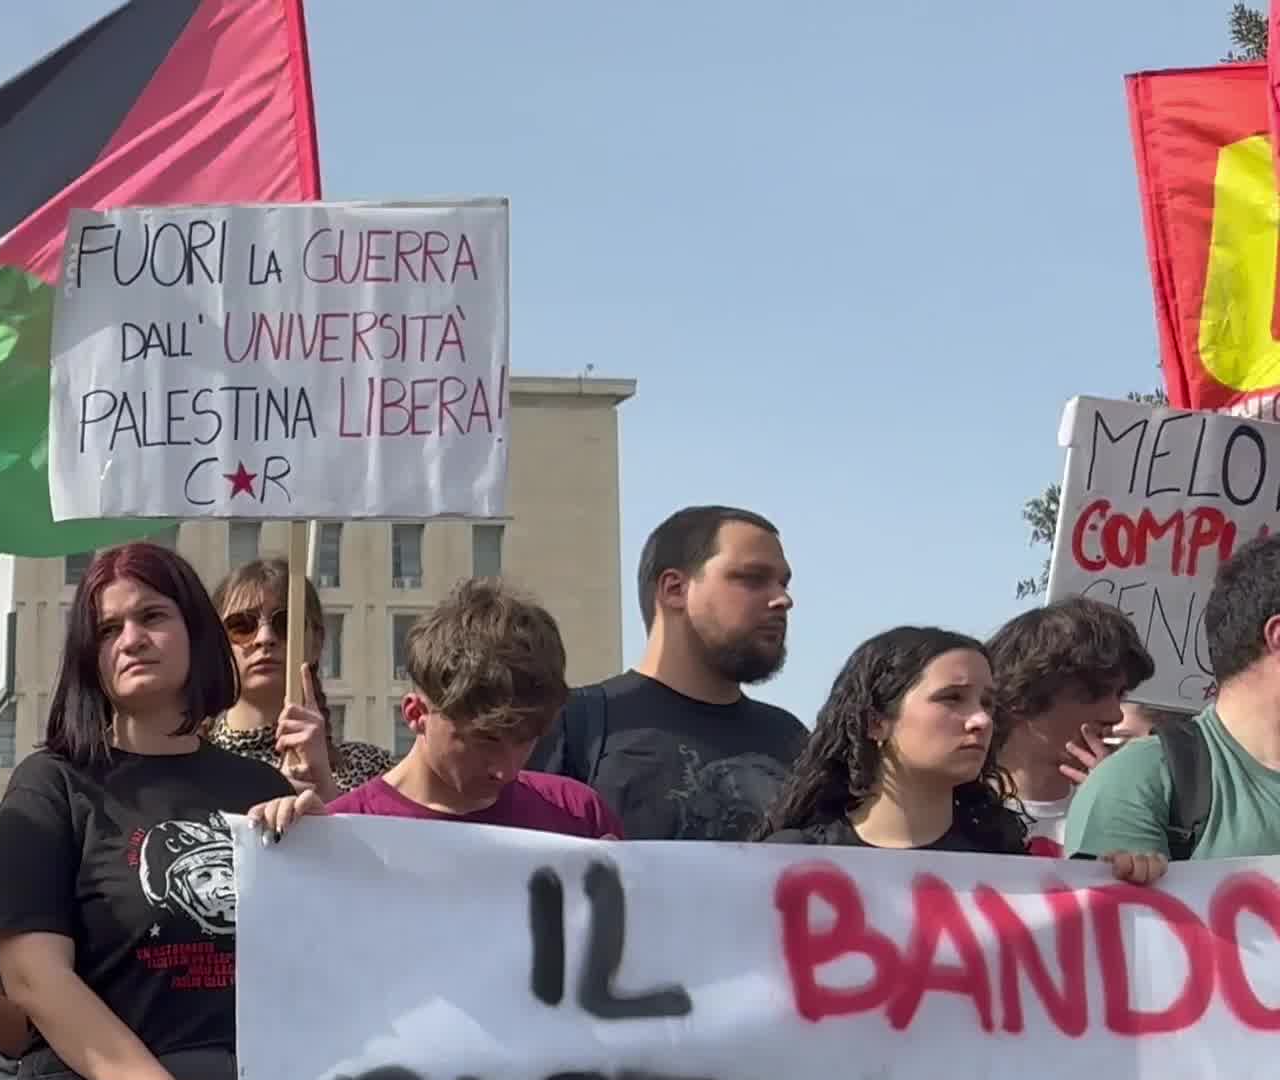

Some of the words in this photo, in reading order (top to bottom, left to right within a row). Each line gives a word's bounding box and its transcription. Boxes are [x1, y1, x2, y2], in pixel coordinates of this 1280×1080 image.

[77, 219, 227, 288] FUORI
[249, 244, 282, 285] LA
[303, 228, 479, 283] GUERRA
[223, 305, 466, 363] UNIVERSITÀ
[80, 384, 317, 453] PALESTINA
[339, 365, 506, 443] LIBERA!
[1087, 409, 1280, 512] MELO
[526, 858, 692, 1019] IL
